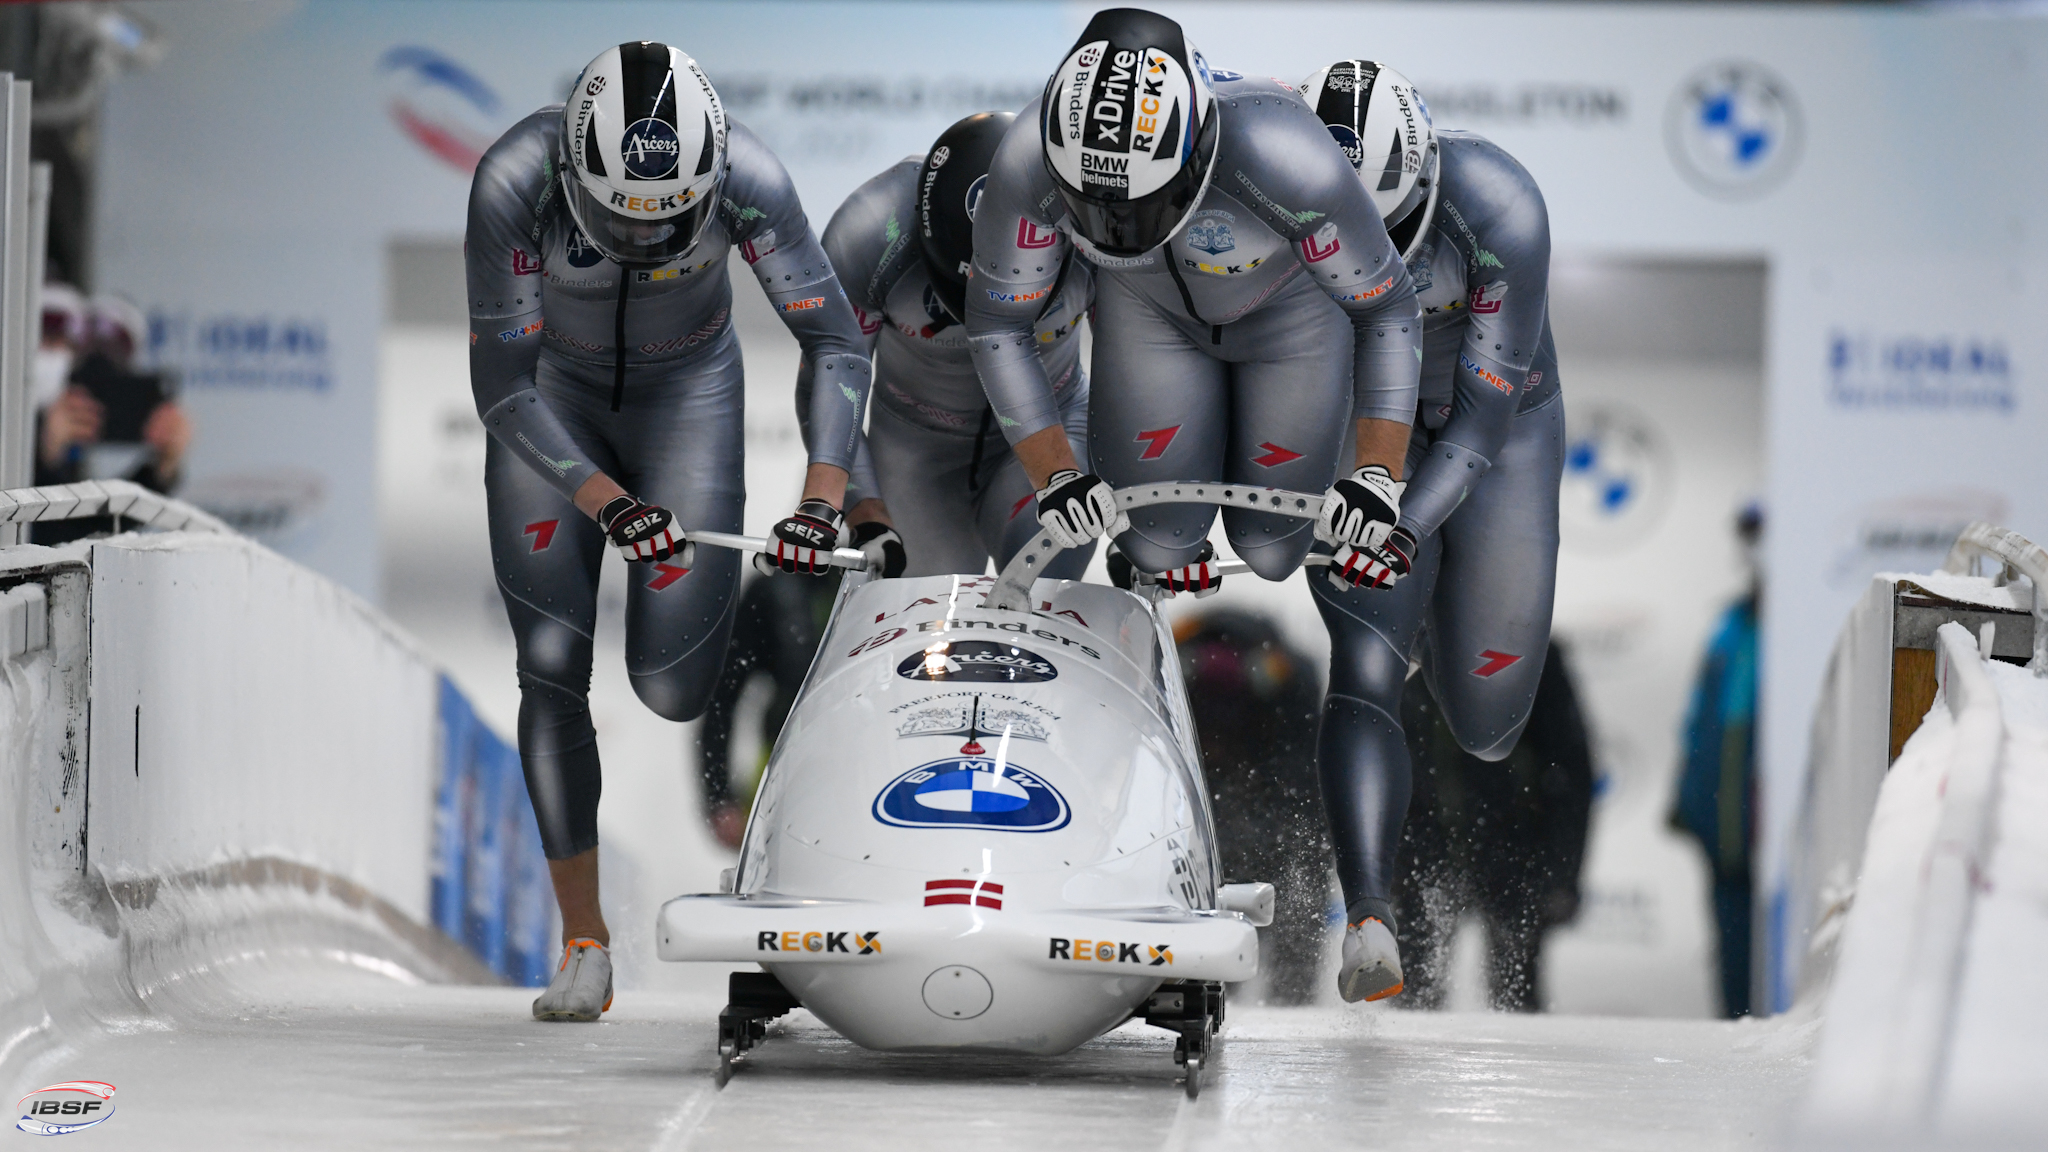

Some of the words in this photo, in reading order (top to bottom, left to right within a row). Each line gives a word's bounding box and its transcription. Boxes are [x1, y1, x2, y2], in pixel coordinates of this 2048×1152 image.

[688, 64, 723, 126] Binders
[1069, 71, 1090, 140] Binders
[1093, 50, 1136, 145] xDrive
[574, 99, 594, 167] Binders
[1391, 85, 1418, 146] Binders
[1081, 153, 1129, 173] BMW
[1082, 169, 1128, 188] helmets
[922, 170, 938, 238] Binders
[1088, 252, 1155, 267] Binders
[550, 274, 613, 288] Binders
[1369, 546, 1399, 567] EIZ
[916, 618, 1101, 660] Binders
[991, 693, 1018, 701] OF
[905, 760, 1043, 789] BMW
